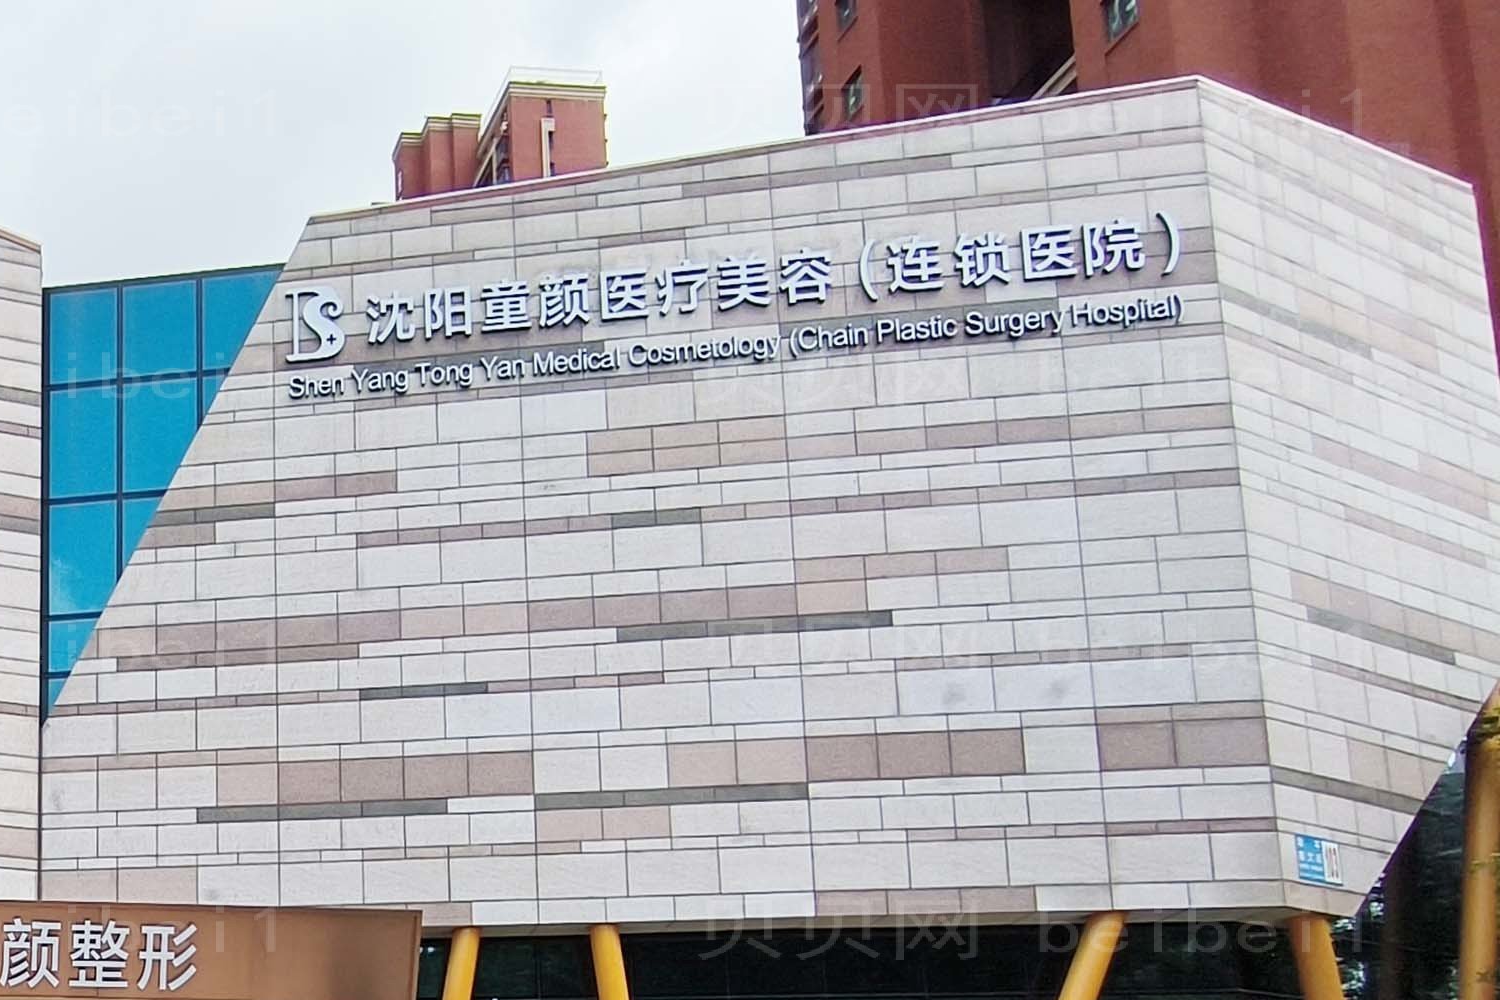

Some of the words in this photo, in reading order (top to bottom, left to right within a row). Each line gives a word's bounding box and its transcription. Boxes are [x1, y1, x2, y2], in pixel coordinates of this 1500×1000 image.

[289, 374, 344, 399] Shen
[352, 368, 408, 394] Yang
[416, 361, 472, 387] Tong
[480, 355, 525, 380] Yan
[533, 344, 621, 375] Medical
[629, 335, 781, 366] Cosmetology
[789, 321, 869, 358] (Chain
[877, 313, 958, 344] Plastic
[965, 310, 1066, 338] Surgery
[1071, 295, 1185, 326] Hospital)
